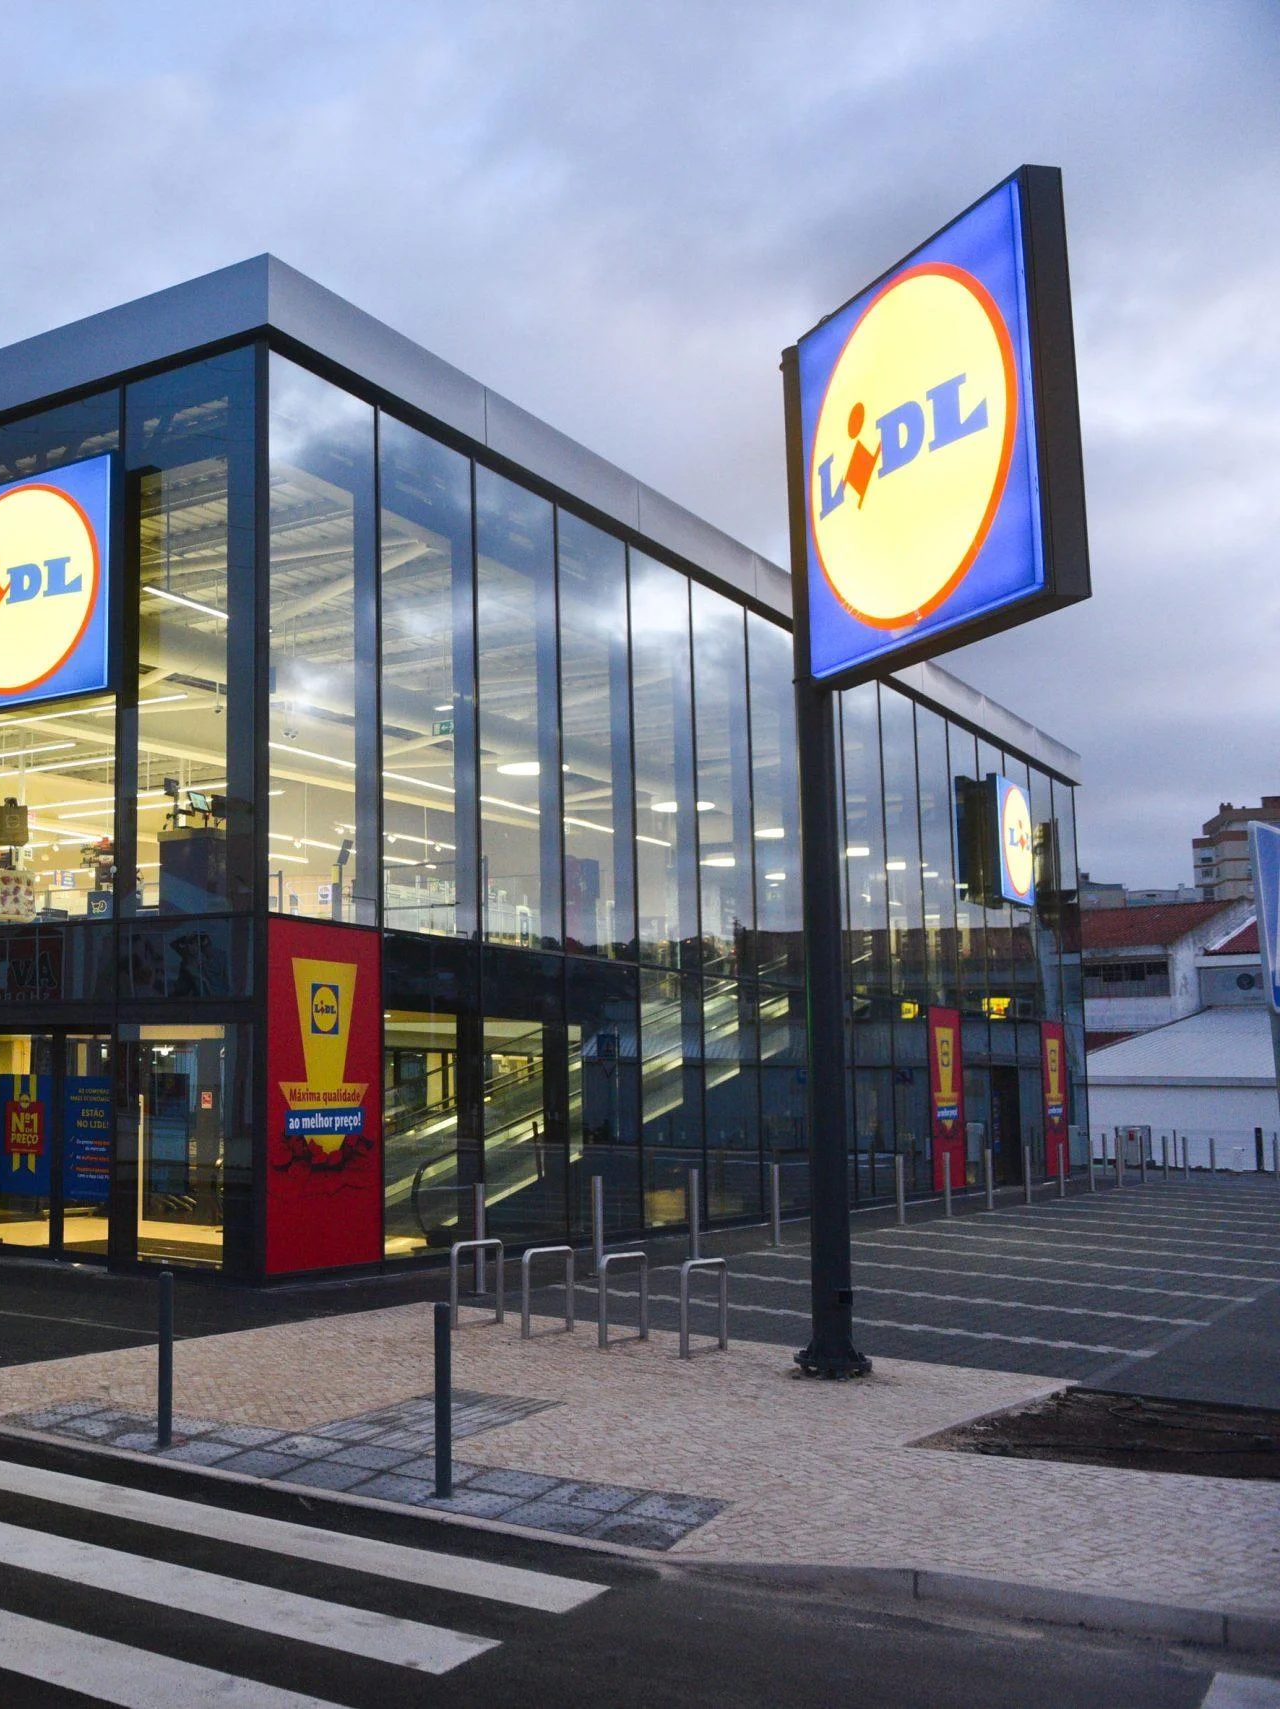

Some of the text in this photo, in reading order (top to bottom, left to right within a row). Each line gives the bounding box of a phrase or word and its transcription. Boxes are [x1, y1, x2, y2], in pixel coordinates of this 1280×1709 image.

[289, 1088, 361, 1106] Máxima qualidade
[289, 1111, 362, 1132] ao melhor preço!
[11, 1133, 39, 1146] PREÇO
